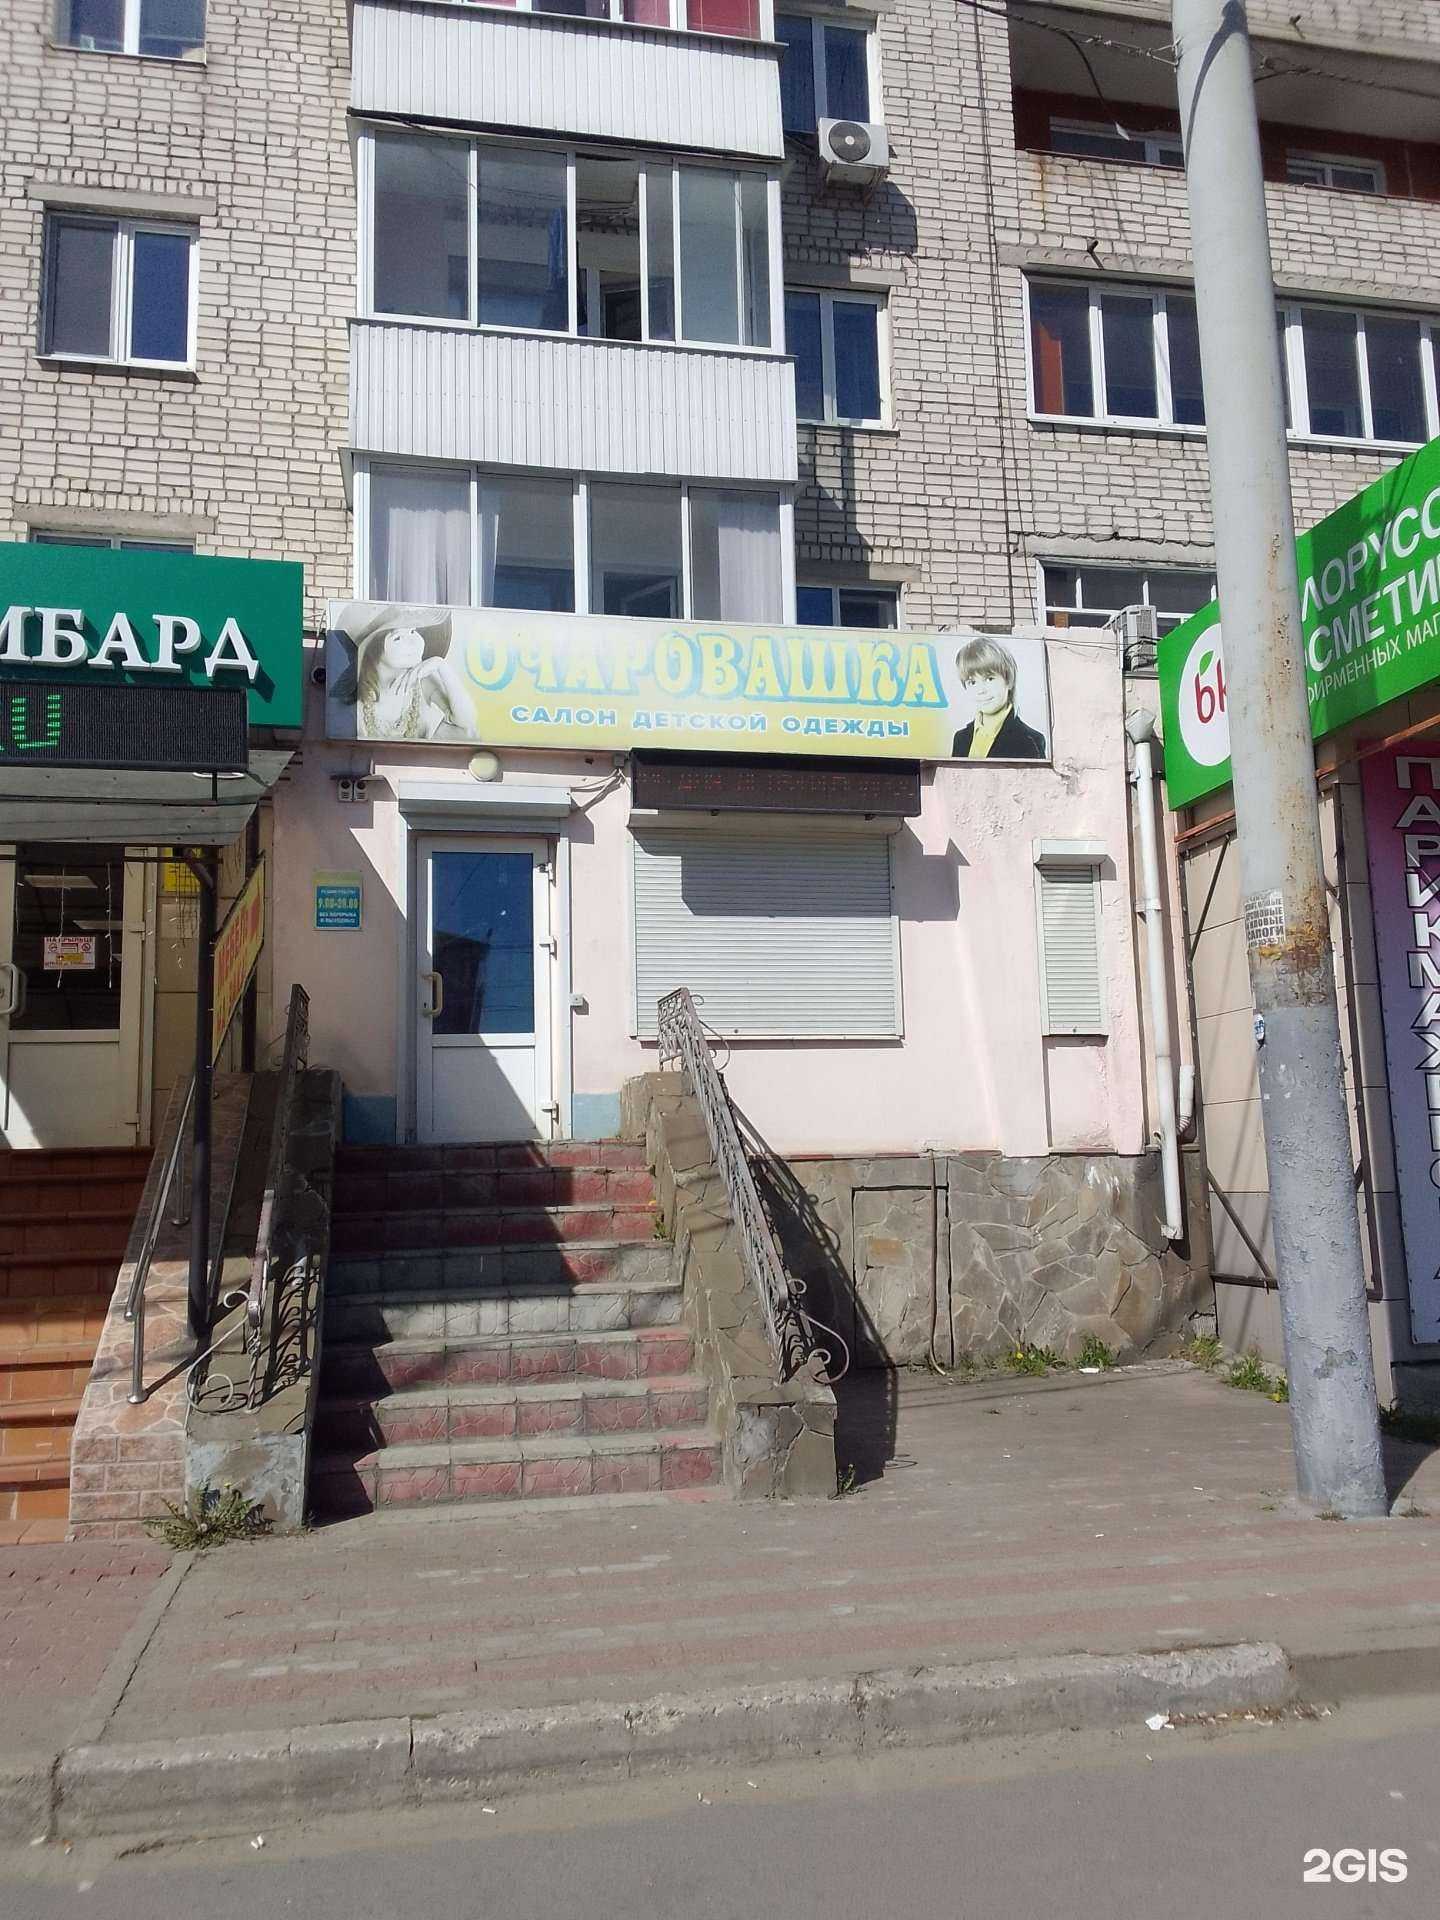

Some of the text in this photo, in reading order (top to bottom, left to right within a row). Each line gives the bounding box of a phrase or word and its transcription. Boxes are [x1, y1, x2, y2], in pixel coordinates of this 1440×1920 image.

[1301, 486, 1440, 622] ЛОРУСС
[1304, 552, 1440, 671] СМЕТИ
[1406, 612, 1440, 650] МАГ
[465, 630, 949, 708] ОЧАРОВАШКА
[511, 706, 910, 737] САЛОН ДЕТСКОЙ ОДЕЖДЫ
